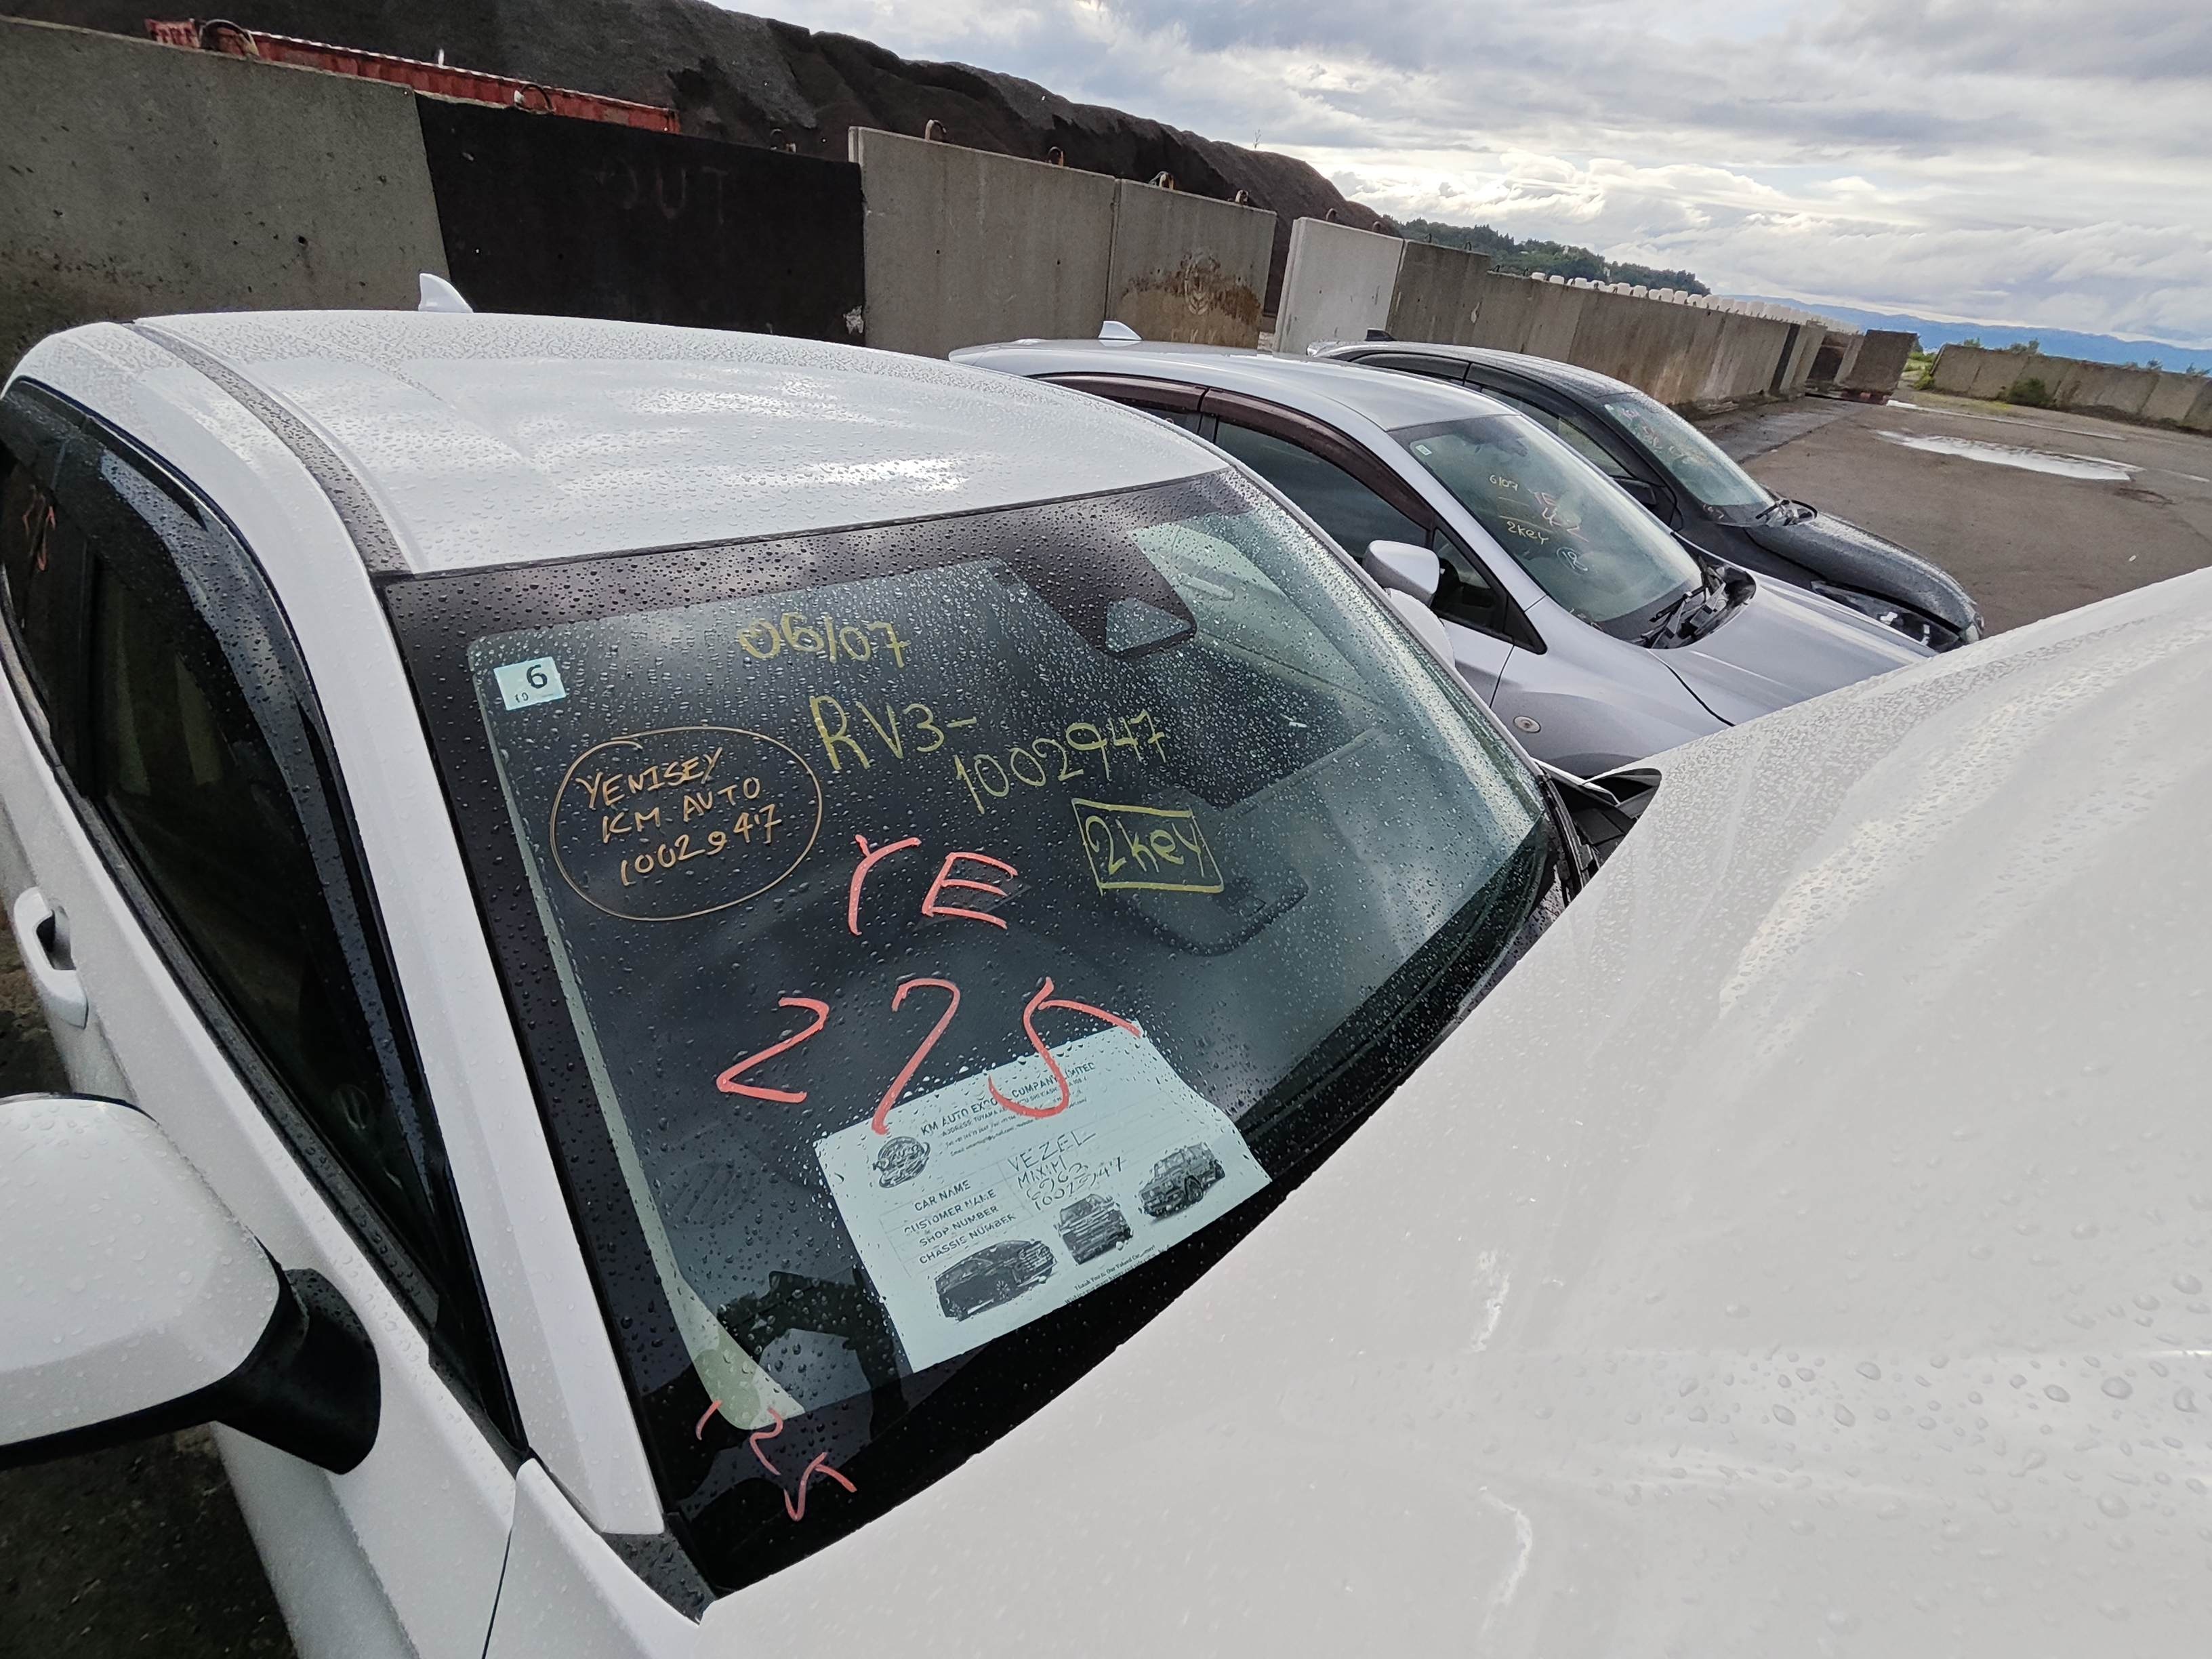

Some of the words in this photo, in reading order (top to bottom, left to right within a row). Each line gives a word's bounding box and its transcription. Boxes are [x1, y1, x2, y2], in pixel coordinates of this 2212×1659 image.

[526, 664, 548, 689] 6
[576, 747, 722, 810] YENISEY
[953, 710, 1168, 815] 1002947
[602, 811, 661, 844] KM
[682, 777, 761, 822] AUTO
[847, 834, 1017, 936] YE
[920, 1121, 939, 1136] KM
[942, 1108, 969, 1127] AUTO
[1008, 1131, 1097, 1172] VEZEL
[914, 1195, 937, 1212] CAR
[939, 1179, 971, 1201] NAME
[919, 1227, 949, 1247] SHOP
[952, 1206, 999, 1231] NUMBER
